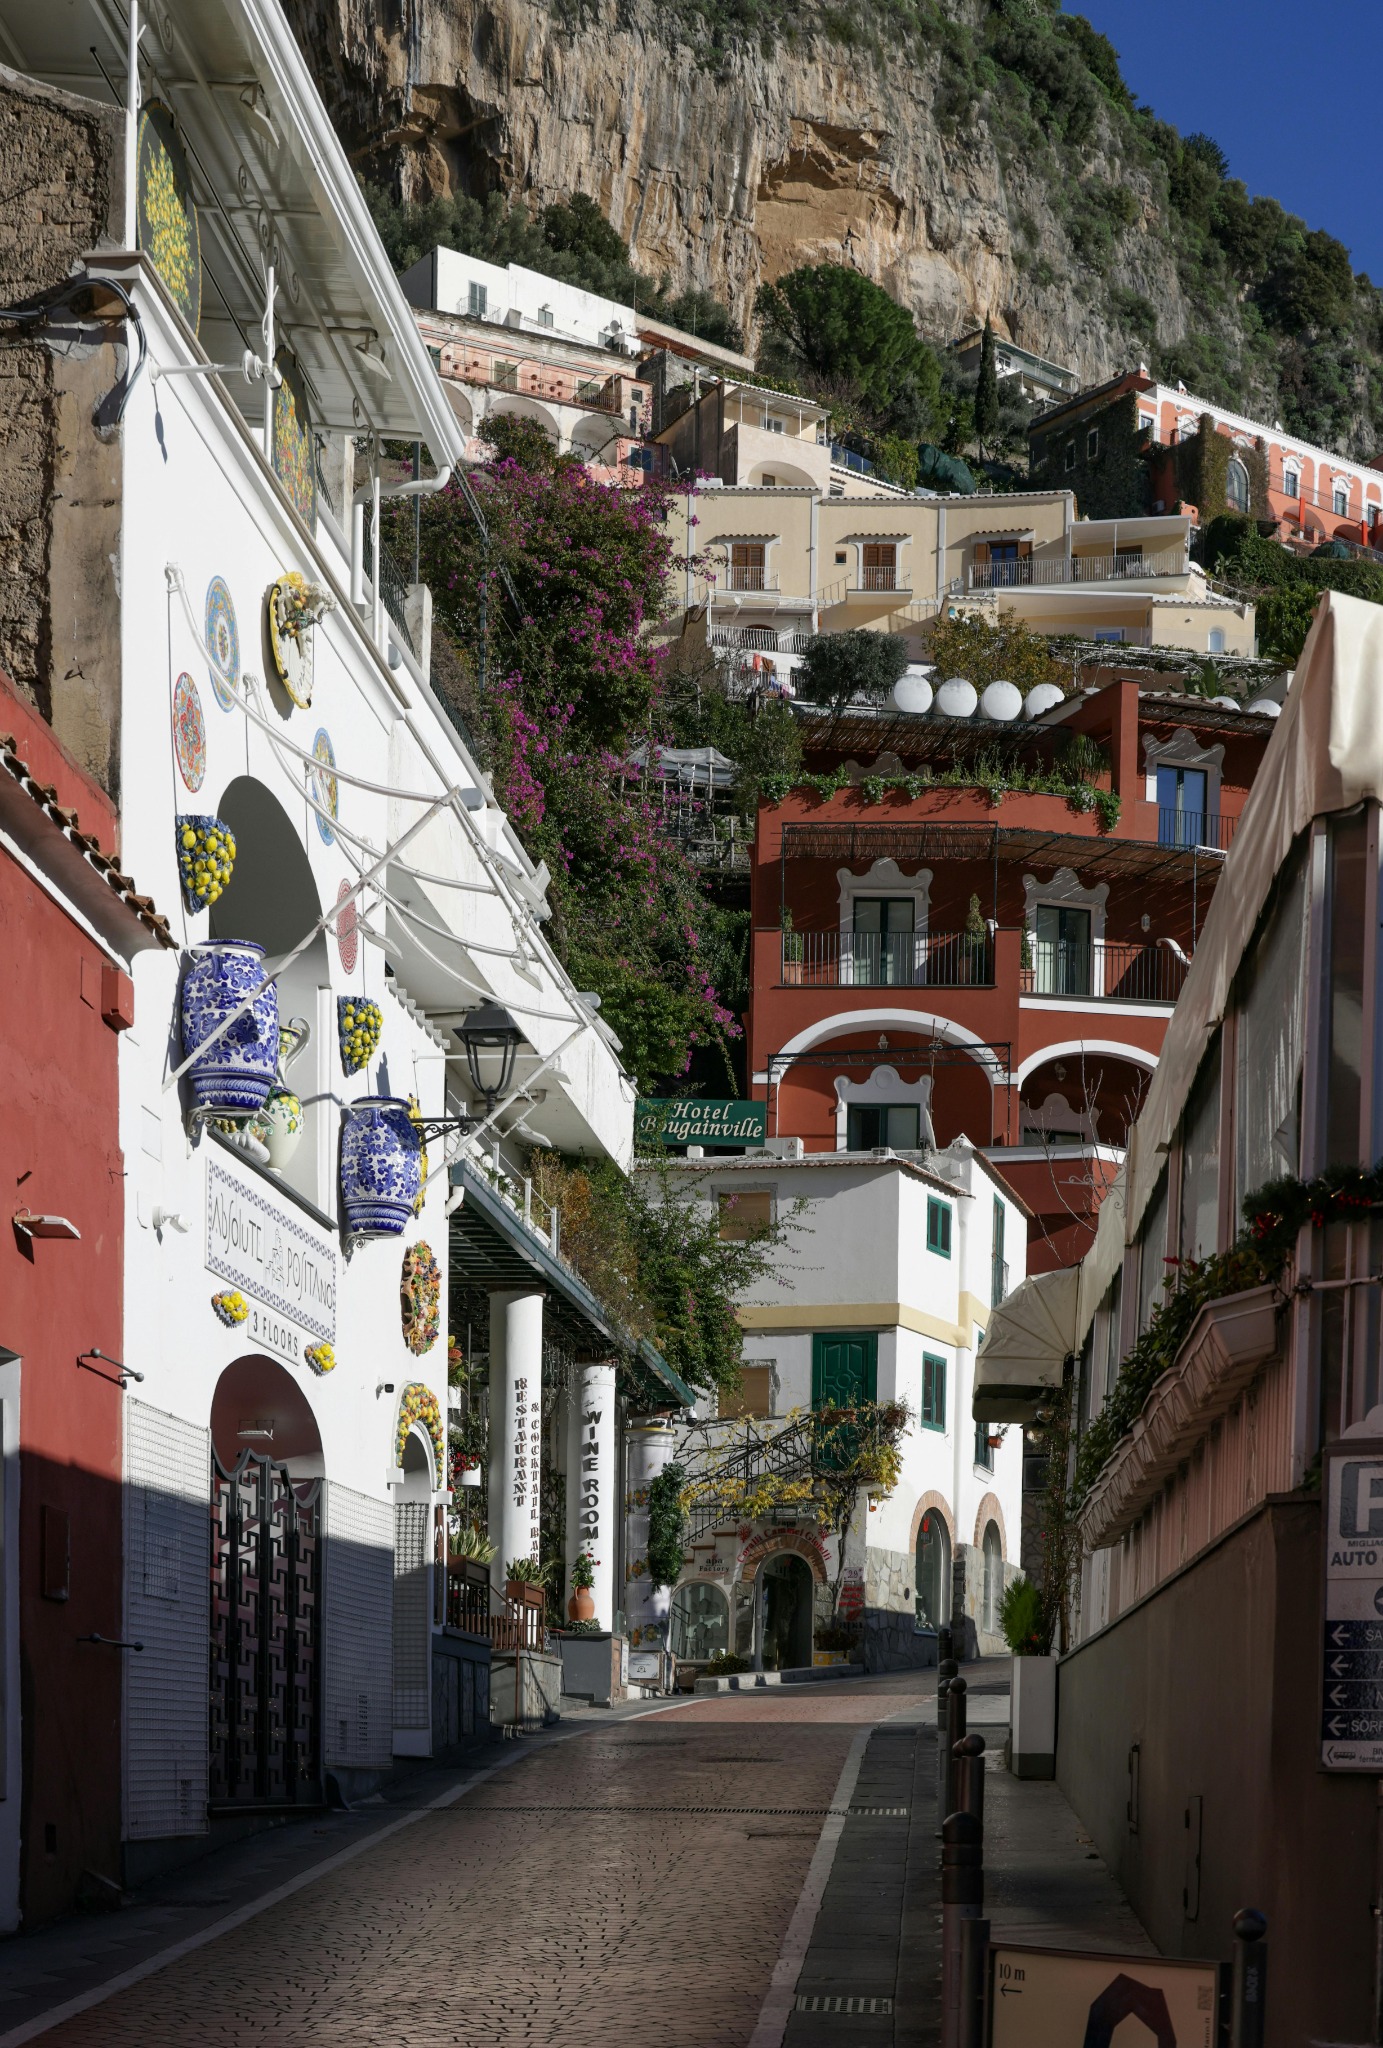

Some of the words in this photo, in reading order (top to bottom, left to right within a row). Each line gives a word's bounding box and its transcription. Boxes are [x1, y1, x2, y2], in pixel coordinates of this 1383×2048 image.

[671, 1101, 734, 1121] Hotel
[253, 1310, 258, 1333] 3
[262, 1316, 298, 1357] FLOORS
[530, 1402, 540, 1413] &
[514, 1377, 528, 1508] RESTAURANT
[586, 1410, 603, 1472] WINE
[530, 1419, 540, 1520] COCKTAIL
[586, 1478, 600, 1541] ROOM
[530, 1526, 540, 1566] BAR
[705, 1558, 723, 1566] apa
[736, 1533, 763, 1563] Coralli
[804, 1531, 832, 1561] Gioielli
[1330, 1550, 1378, 1567] AUTO
[698, 1565, 730, 1573] Factory
[999, 1962, 1012, 1980] 10
[1014, 1968, 1026, 1982] m
